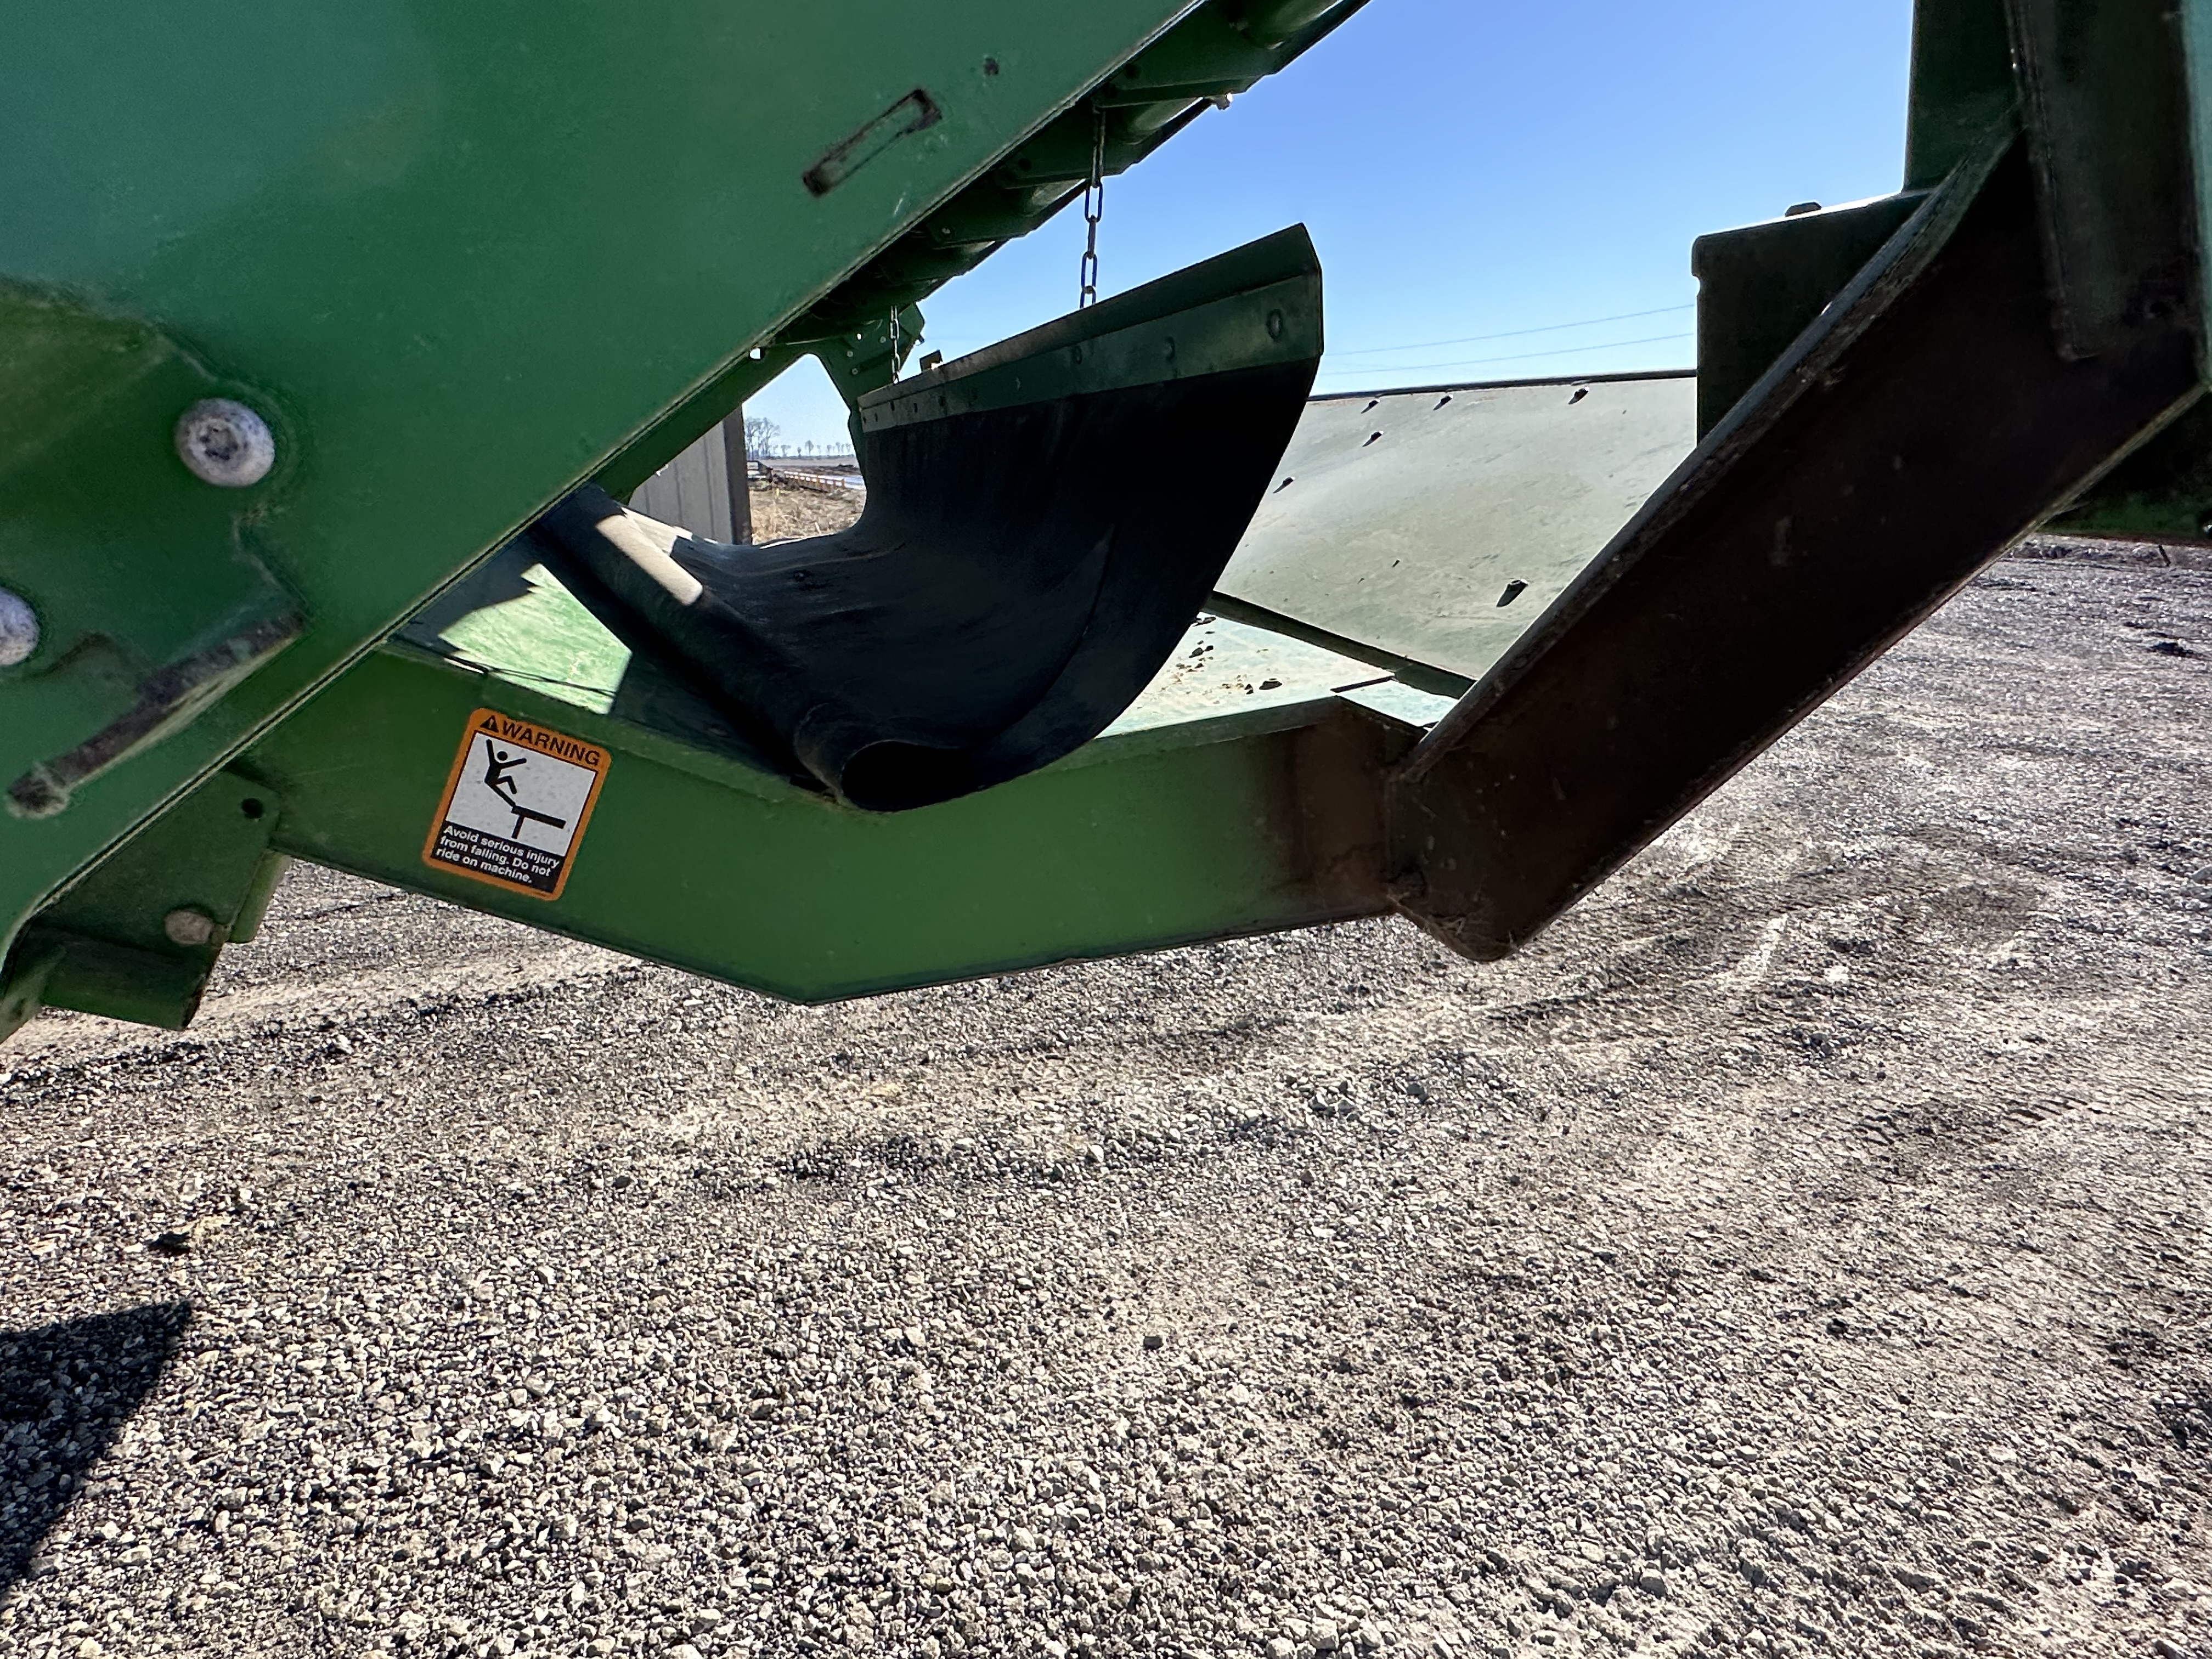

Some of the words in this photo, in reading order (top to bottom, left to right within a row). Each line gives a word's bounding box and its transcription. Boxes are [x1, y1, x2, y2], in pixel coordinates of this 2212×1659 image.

[503, 720, 601, 766] WARNING
[436, 848, 460, 861] ride
[462, 856, 478, 867] on
[481, 861, 532, 883] machine.
[440, 836, 468, 851] from
[471, 844, 509, 865] falling.
[512, 858, 528, 870] Do
[532, 866, 551, 877] not
[443, 825, 479, 843] Avoid
[481, 837, 524, 856] serious
[527, 849, 560, 869] injury
